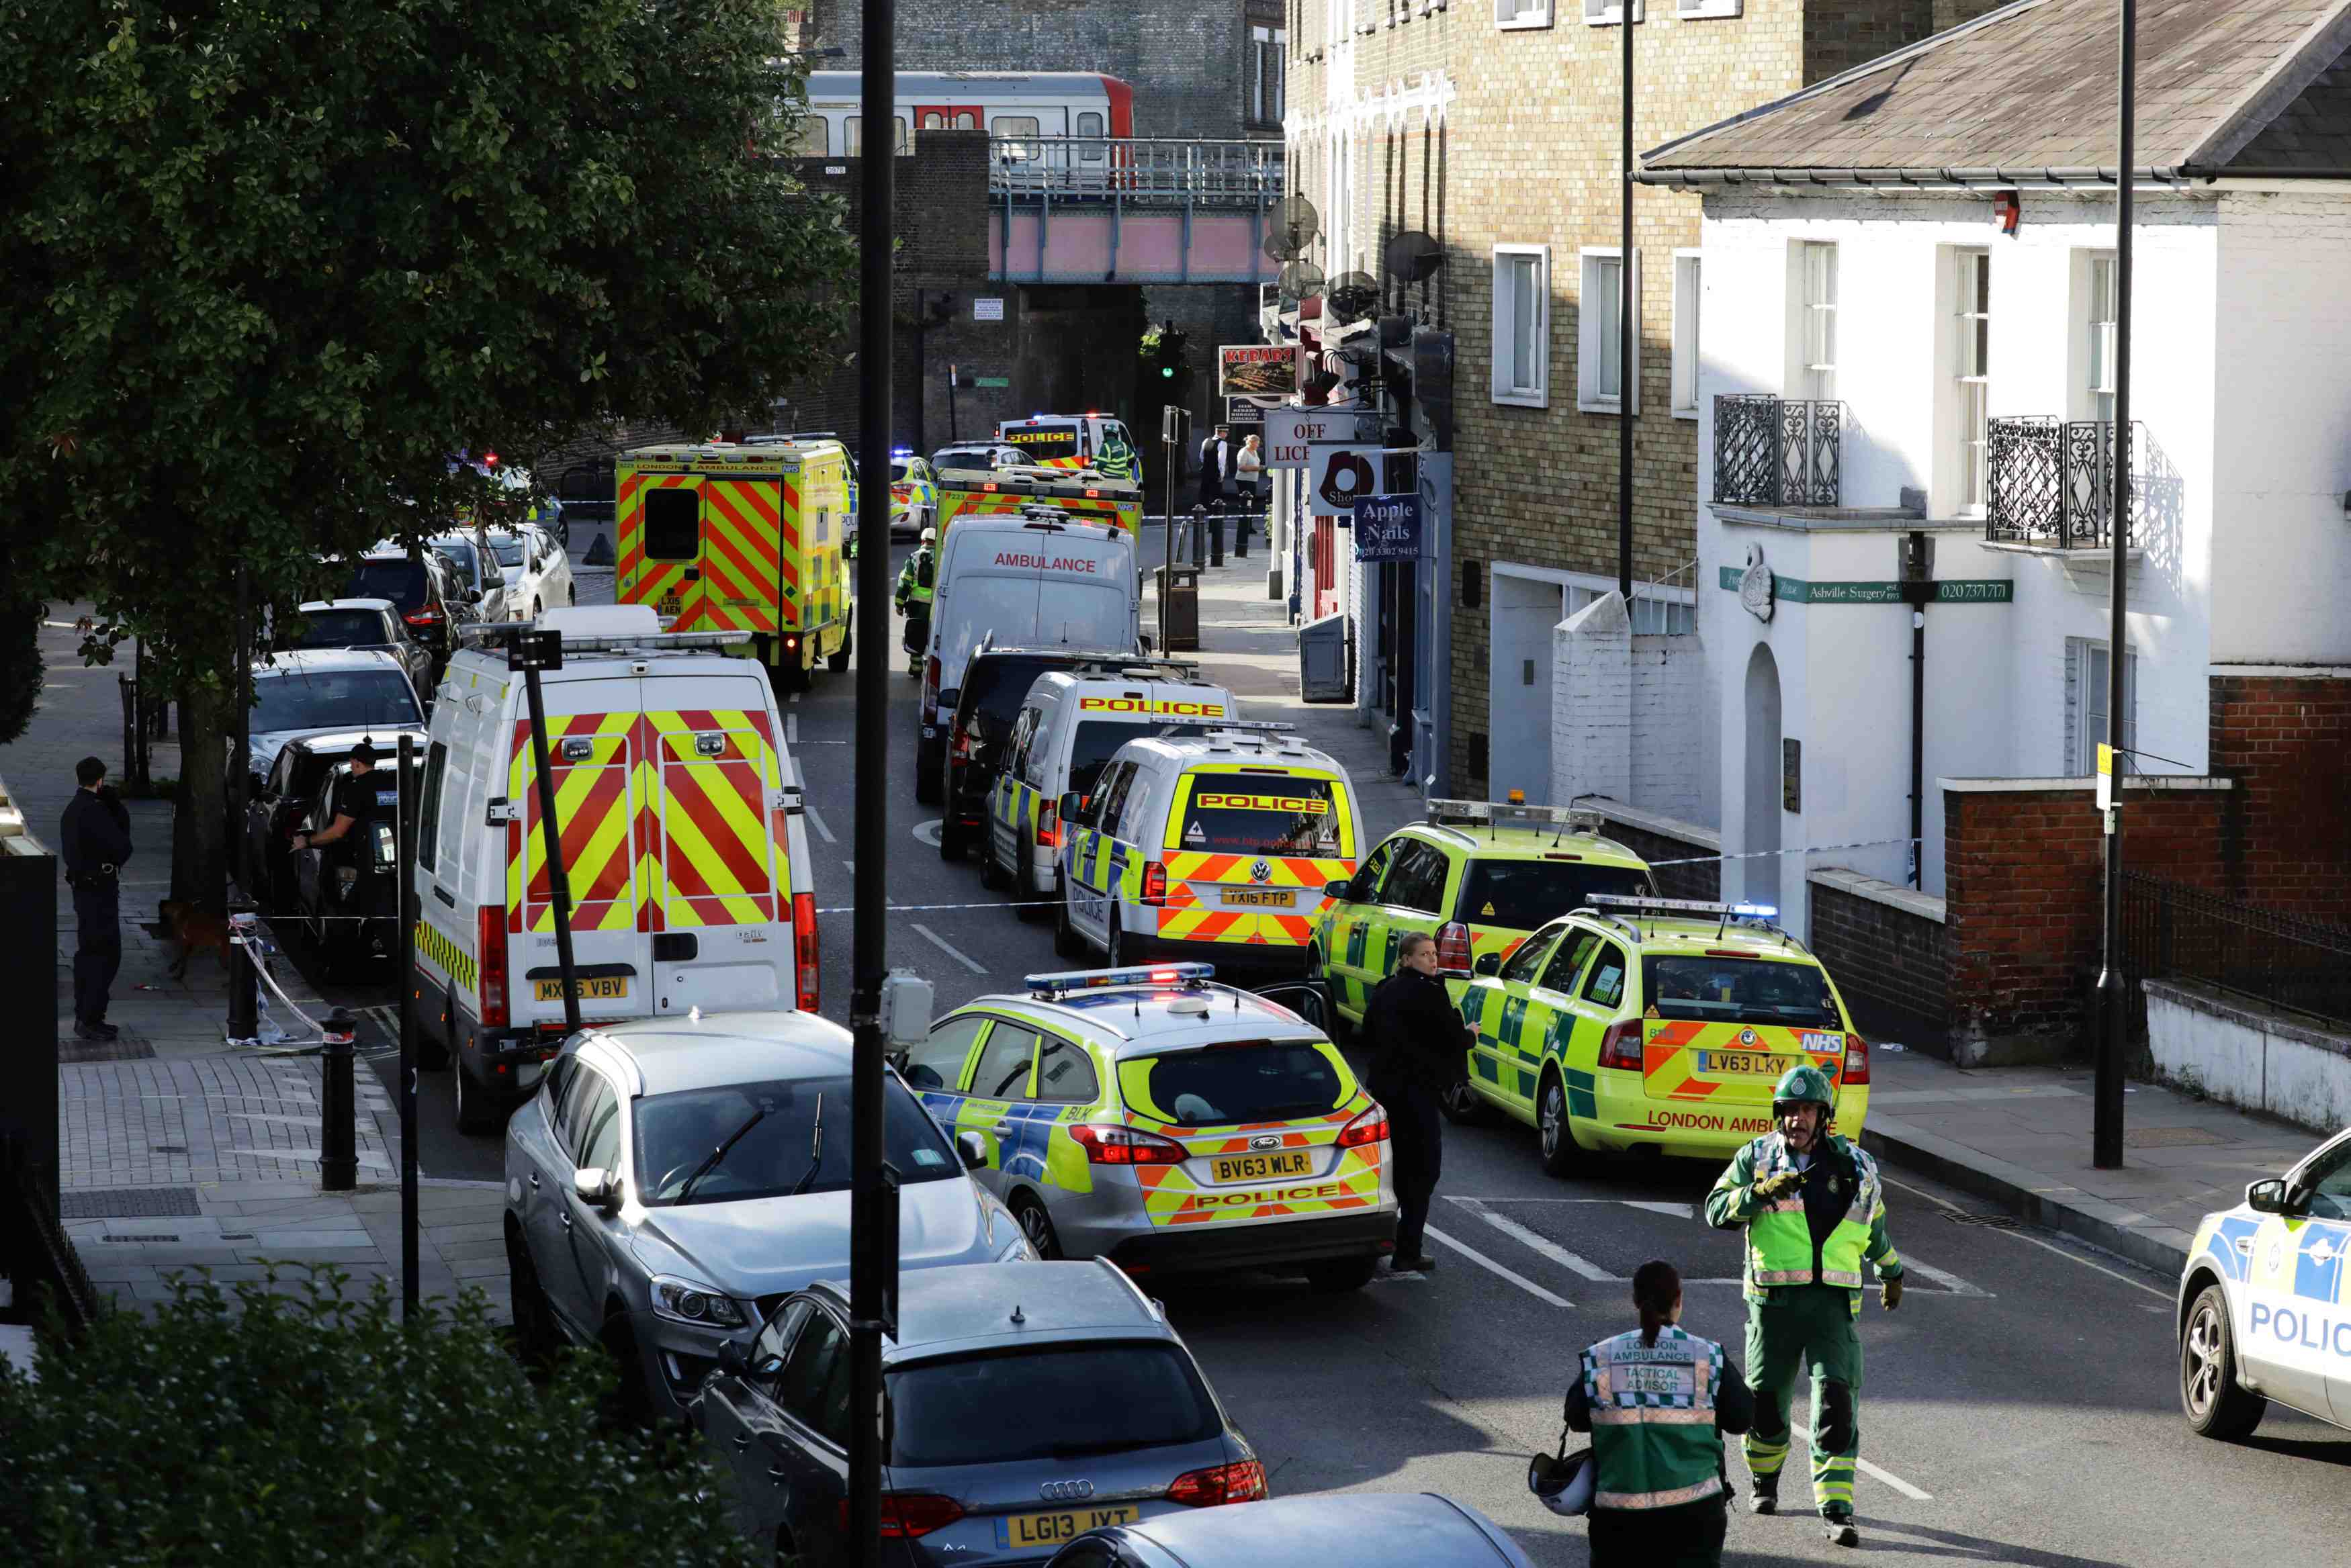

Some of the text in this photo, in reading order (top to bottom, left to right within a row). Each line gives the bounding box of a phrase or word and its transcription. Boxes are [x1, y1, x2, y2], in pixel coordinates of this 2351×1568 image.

[1225, 349, 1292, 363] KEBABS
[1007, 432, 1074, 442] POLICE
[1294, 424, 1326, 439] OFF
[783, 465, 799, 473] NHS
[1329, 491, 1354, 502] Sho
[1362, 502, 1413, 522] Apple
[1366, 525, 1410, 541] Nails
[1398, 546, 1419, 555] 9415
[994, 552, 1096, 573] AMBULANCE
[1809, 586, 1847, 598] Ashville
[1849, 586, 1886, 600] Surgery
[1941, 584, 2006, 598] 020 7371 7171
[1079, 698, 1225, 717] POLICE
[378, 794, 398, 804] POLIC
[1200, 794, 1326, 813] POLICE
[1229, 890, 1288, 905] YX16 FTP
[541, 977, 621, 997] MX6 VBV
[1802, 1033, 1841, 1052] NHS
[1708, 1052, 1785, 1074] LV63 LKY
[1065, 1107, 1093, 1122] BLK
[1648, 1110, 1724, 1130] LONDON
[1219, 1155, 1305, 1179] BV63 WLR
[1197, 1185, 1339, 1208] POLICE
[2250, 1302, 2351, 1357] POLIC
[1613, 1351, 1691, 1361] AMBULANCE
[1624, 1368, 1681, 1380] TACTICAL
[1626, 1379, 1678, 1391] ADVISOR
[1019, 1514, 1075, 1542] LG13
